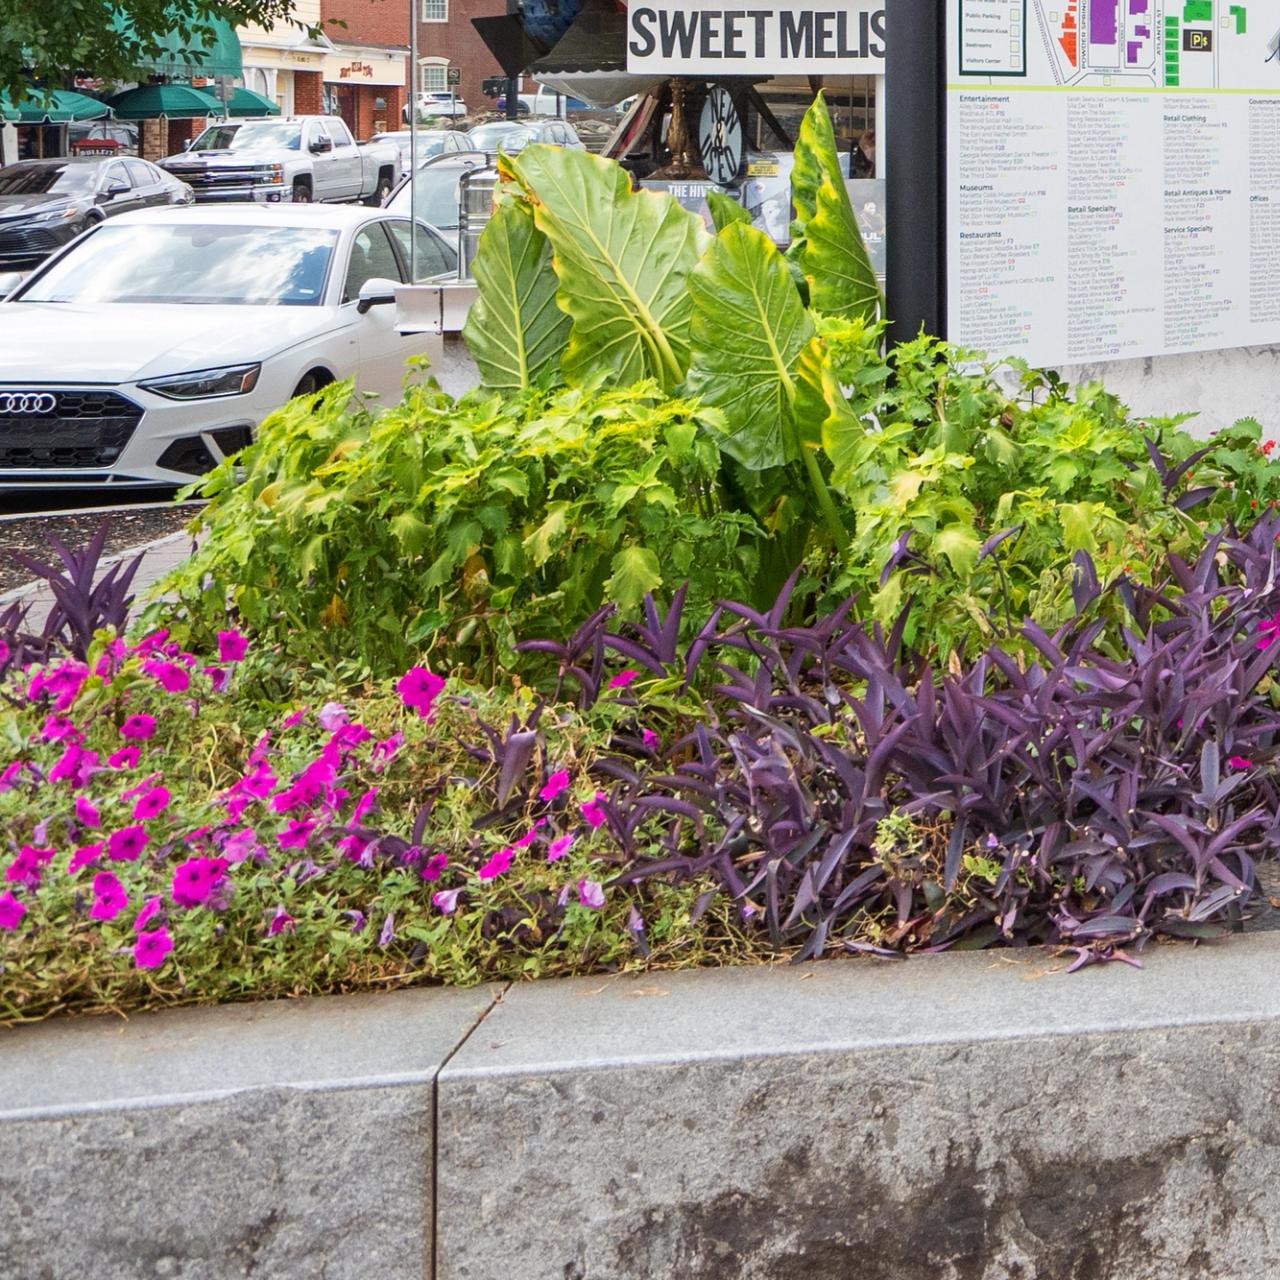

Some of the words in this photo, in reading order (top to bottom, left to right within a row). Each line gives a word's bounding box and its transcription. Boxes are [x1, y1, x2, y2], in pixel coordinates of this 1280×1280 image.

[629, 7, 774, 58] SWEET
[710, 90, 738, 135] NEW
[701, 134, 737, 182] USED
[668, 184, 688, 198] THE
